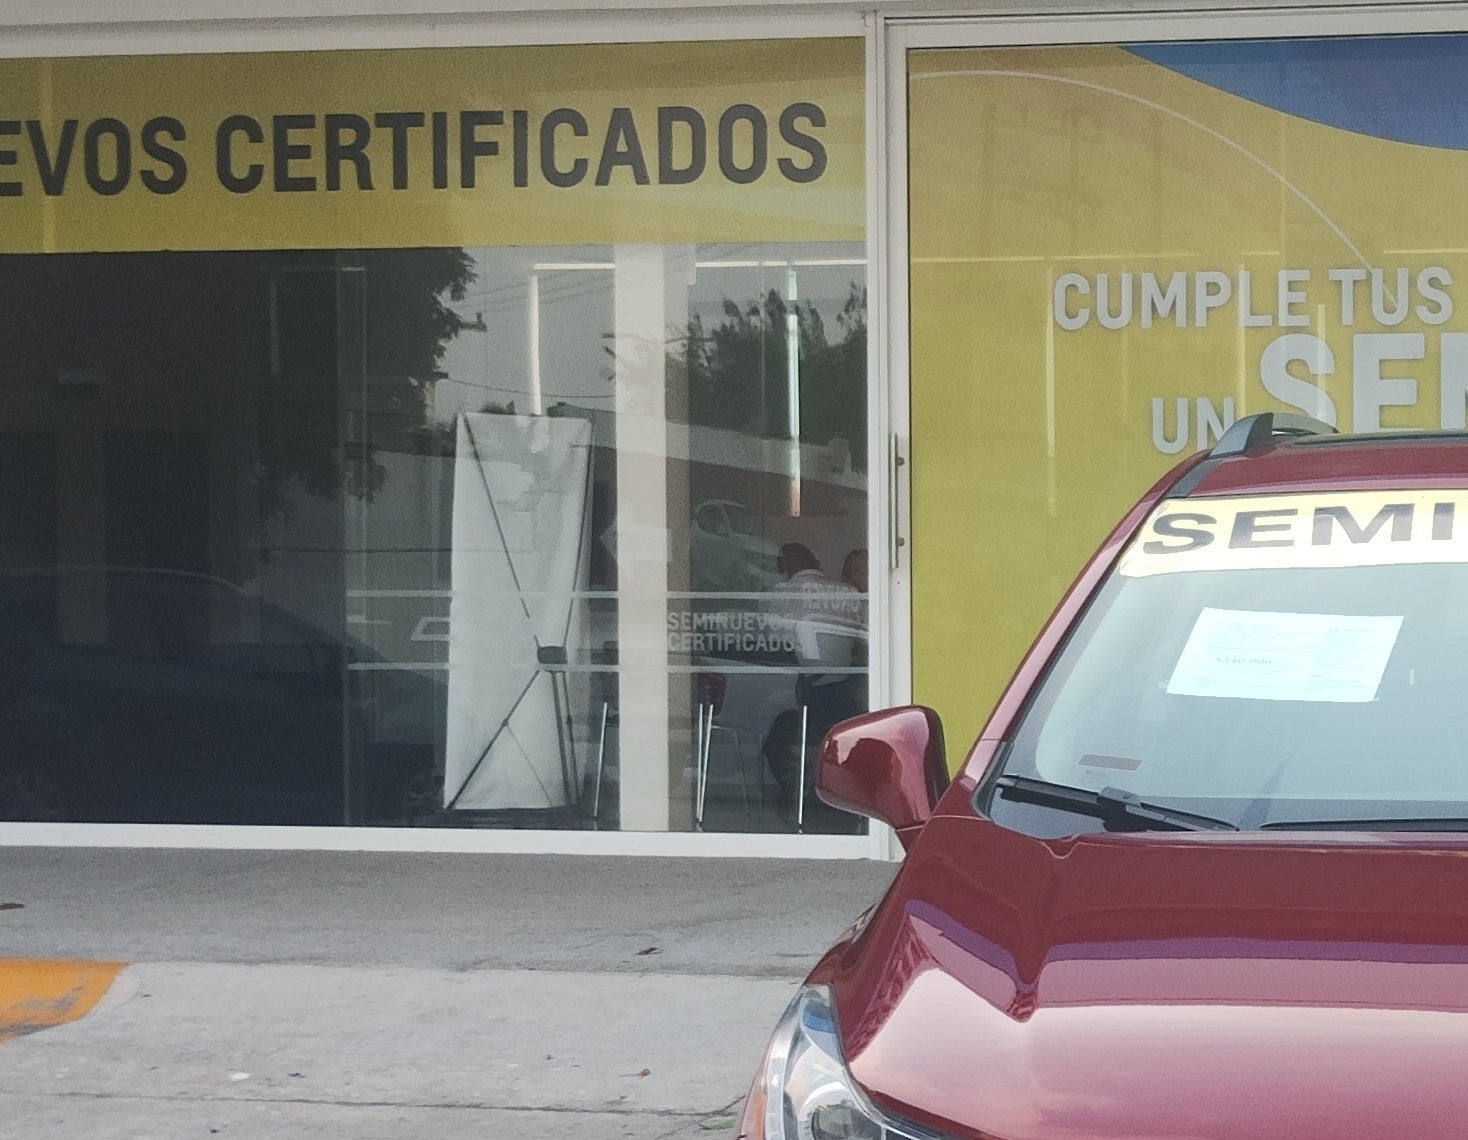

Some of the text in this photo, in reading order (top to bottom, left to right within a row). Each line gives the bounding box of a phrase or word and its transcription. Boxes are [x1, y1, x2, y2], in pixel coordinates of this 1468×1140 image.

[215, 102, 828, 194] CERTIFICADOS
[1054, 269, 1311, 331] CUMPLE
[1329, 266, 1454, 326] TUS
[1151, 396, 1237, 454] UN
[667, 632, 806, 653] CERTIFICADOS
